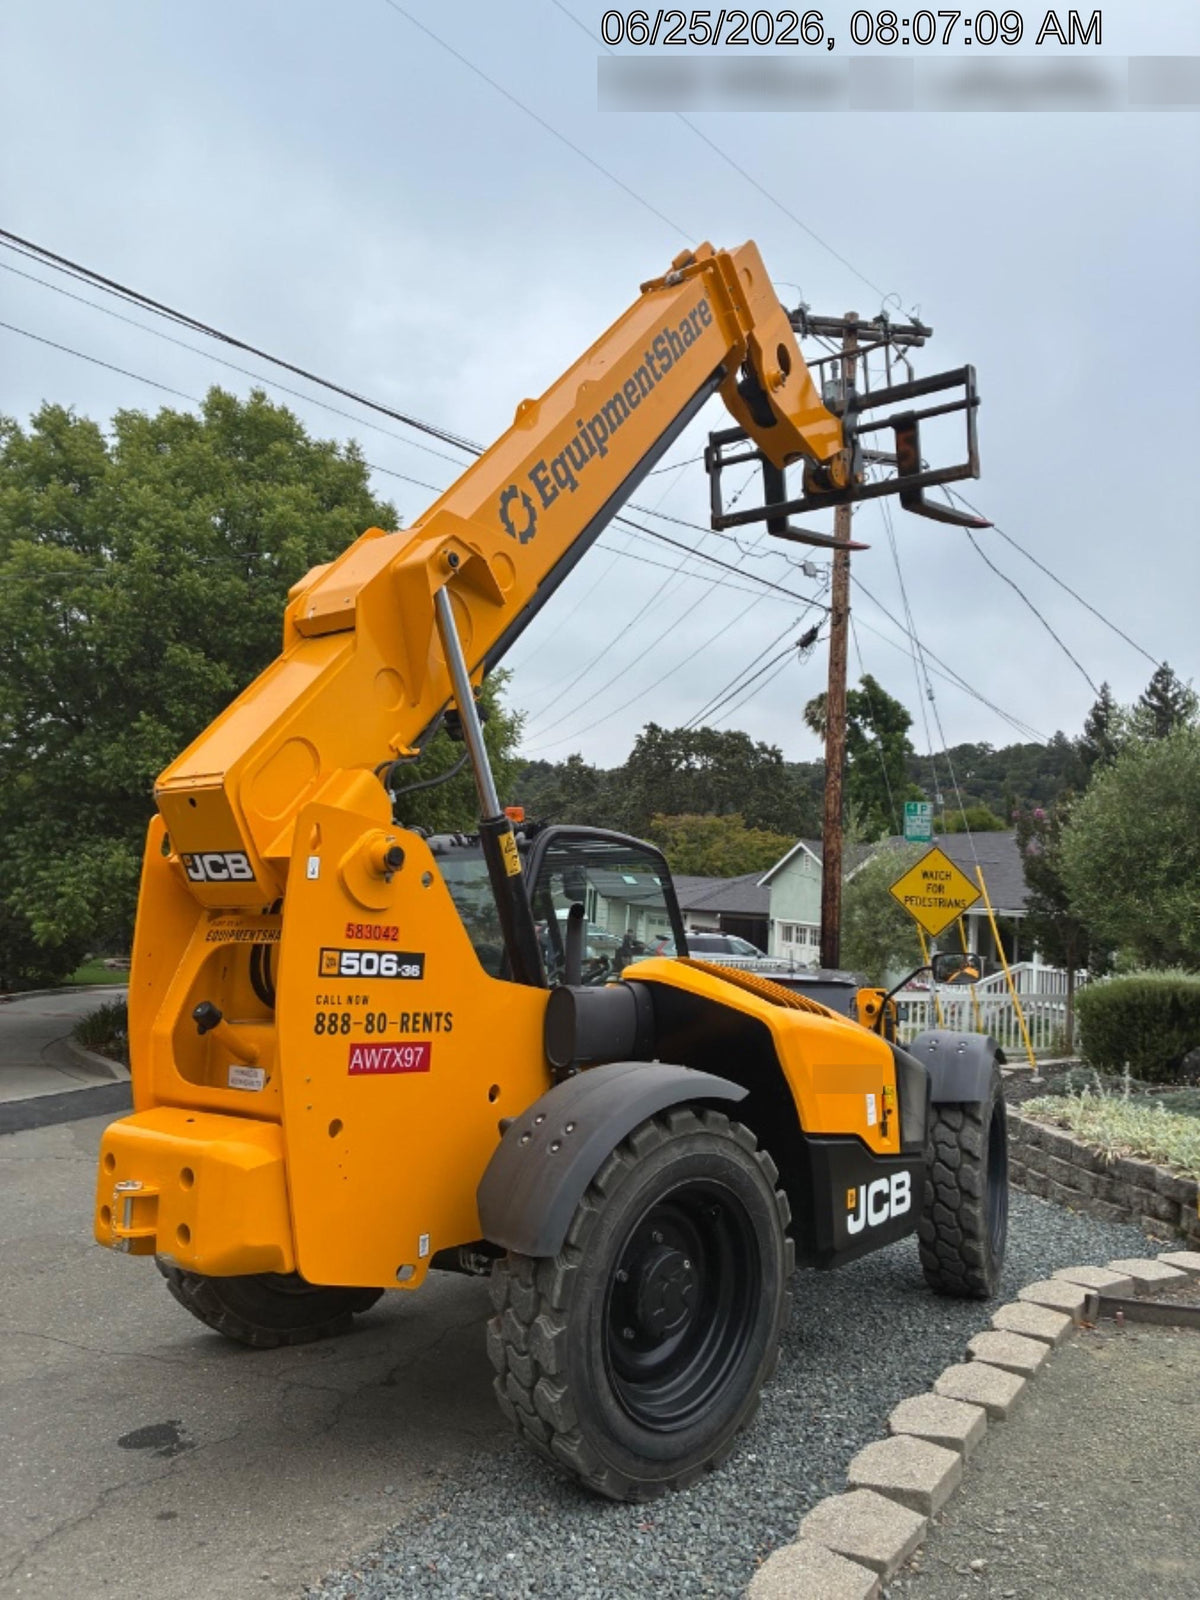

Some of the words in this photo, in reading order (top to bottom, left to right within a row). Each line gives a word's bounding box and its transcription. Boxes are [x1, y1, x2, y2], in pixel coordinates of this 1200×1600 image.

[528, 298, 712, 511] EquipmentShare
[187, 853, 253, 880] JCB
[922, 871, 951, 880] WATCH
[926, 883, 945, 894] FOR
[904, 896, 967, 908] PEDESTRIANS
[345, 922, 400, 942] 583042
[316, 995, 342, 1005] CALL
[347, 995, 369, 1005] NOW
[314, 1012, 453, 1035] 888-80-RENTS
[350, 1047, 424, 1070] AW7X97
[847, 1171, 911, 1234] JCB
